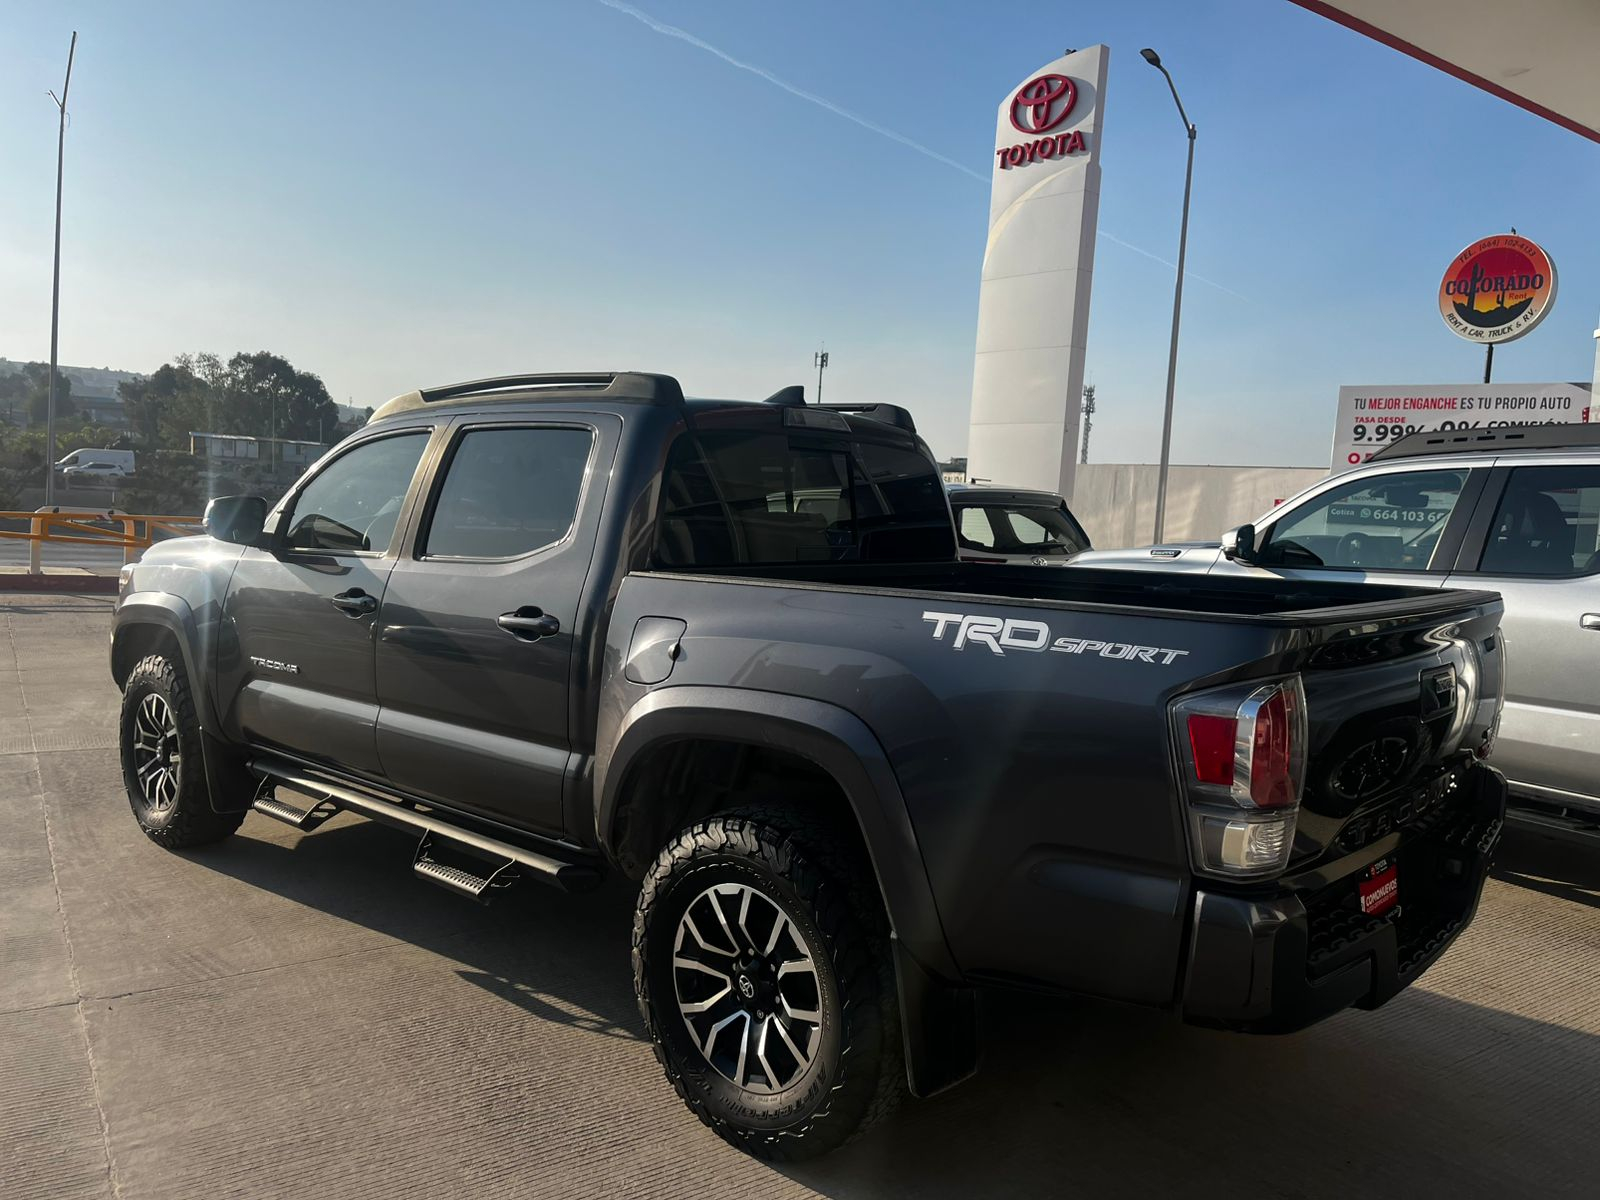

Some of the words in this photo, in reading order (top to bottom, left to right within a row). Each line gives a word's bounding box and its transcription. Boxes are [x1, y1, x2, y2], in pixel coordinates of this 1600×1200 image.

[996, 130, 1086, 169] TOYOTA
[1445, 274, 1543, 296] COLORADO
[1508, 292, 1527, 300] Rent
[1446, 313, 1463, 328] RENT
[1488, 325, 1514, 338] TRUCK
[1354, 398, 1366, 410] TU
[1368, 398, 1401, 410] MEJOR
[1403, 397, 1458, 410] ENGANCHE
[1460, 397, 1474, 410] ES
[1478, 397, 1492, 410] TU
[1495, 397, 1537, 410] PROPIO
[1540, 397, 1571, 410] AUTO
[1373, 509, 1398, 521] 664
[1402, 511, 1424, 522] 103
[922, 611, 1051, 657] TRD
[1050, 637, 1190, 665] SPORT
[250, 656, 298, 673] TACOMA
